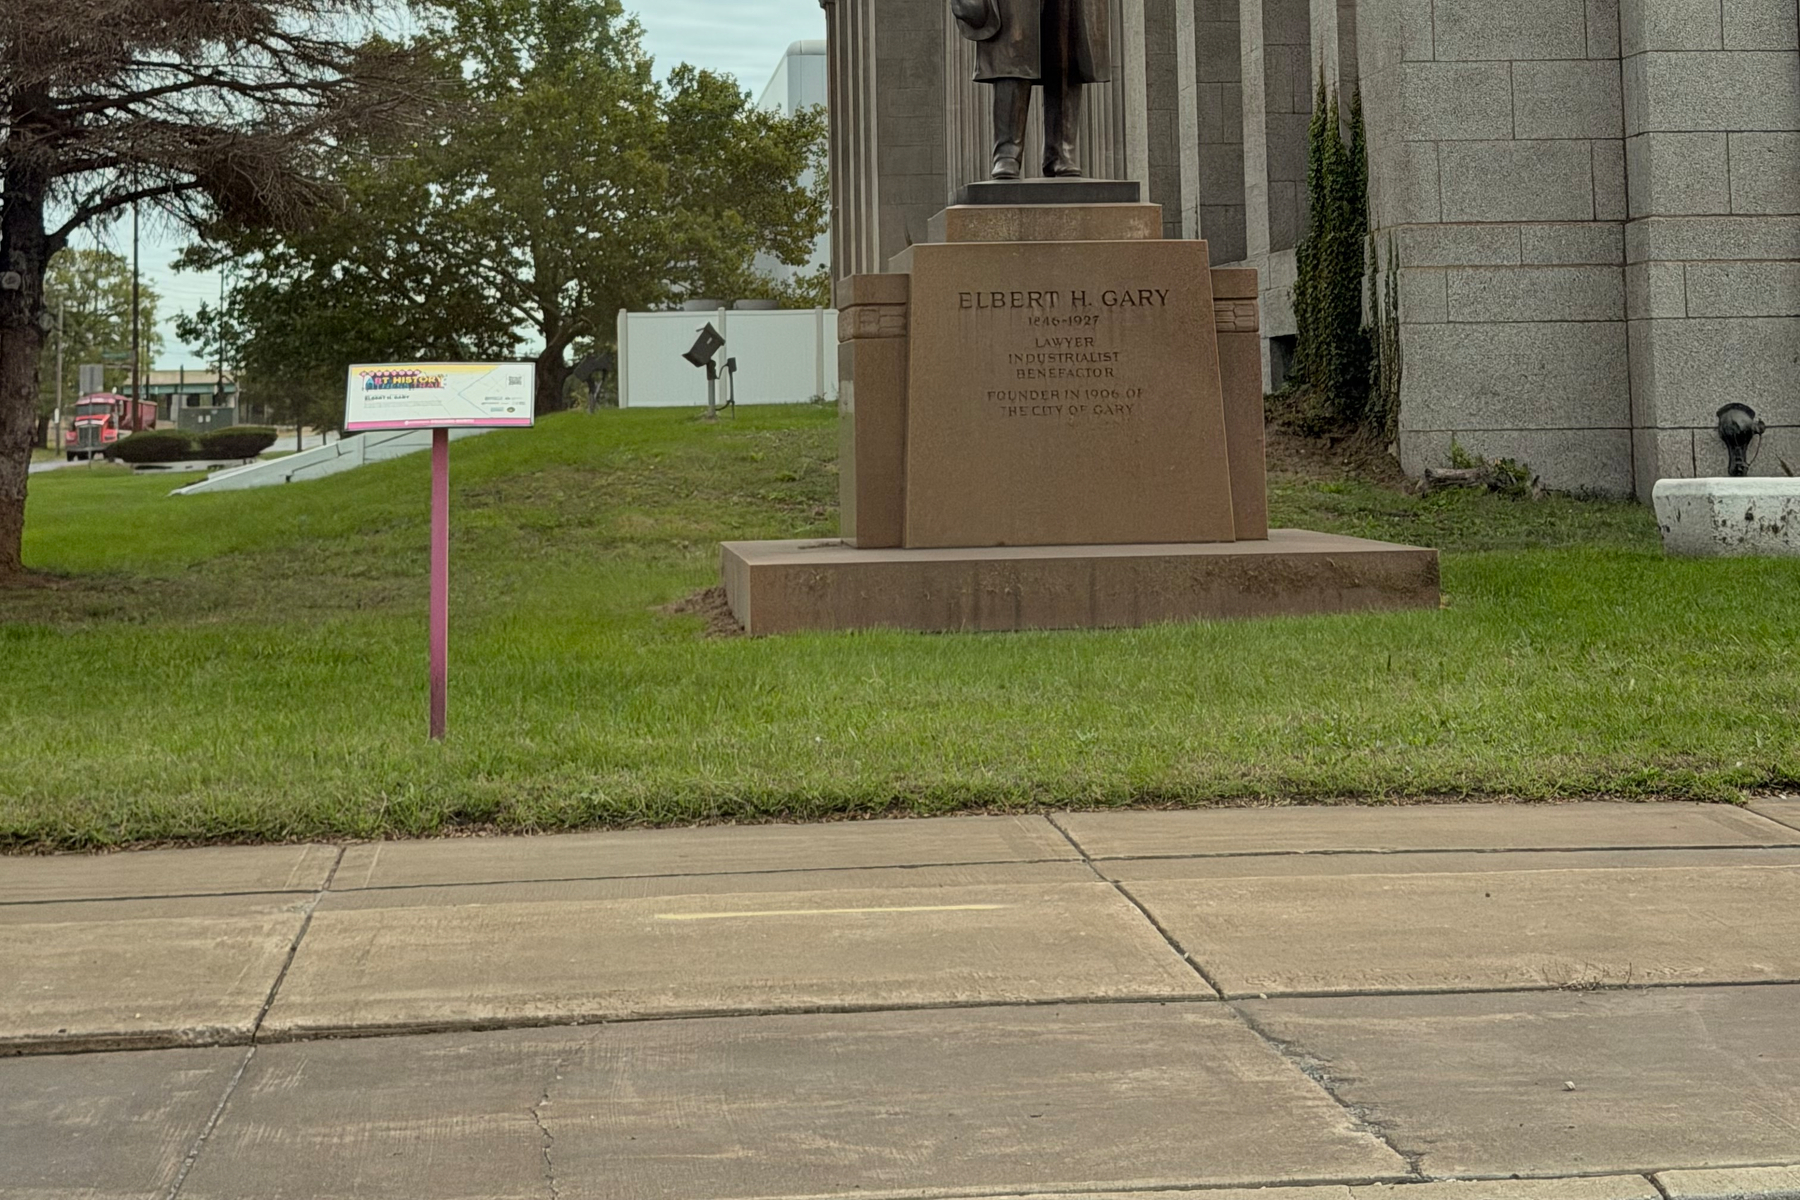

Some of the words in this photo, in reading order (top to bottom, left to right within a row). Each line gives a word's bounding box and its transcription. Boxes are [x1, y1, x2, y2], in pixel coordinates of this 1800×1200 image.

[958, 291, 1060, 309] ELBERT
[1071, 290, 1092, 307] H.
[1101, 289, 1170, 307] GARY
[1028, 315, 1100, 327] 1846-1927
[1035, 337, 1095, 348] LAWYER
[1008, 352, 1119, 365] INDUSTRIALIST
[1016, 368, 1115, 379] BENEFACTOR
[393, 376, 442, 385] HISTORY
[987, 390, 1059, 401] FOUNDER
[1064, 389, 1080, 400] IN
[1085, 388, 1119, 400] 1906
[1032, 405, 1064, 416] CITY
[1068, 405, 1087, 416] OF
[1093, 404, 1133, 416] GARY
